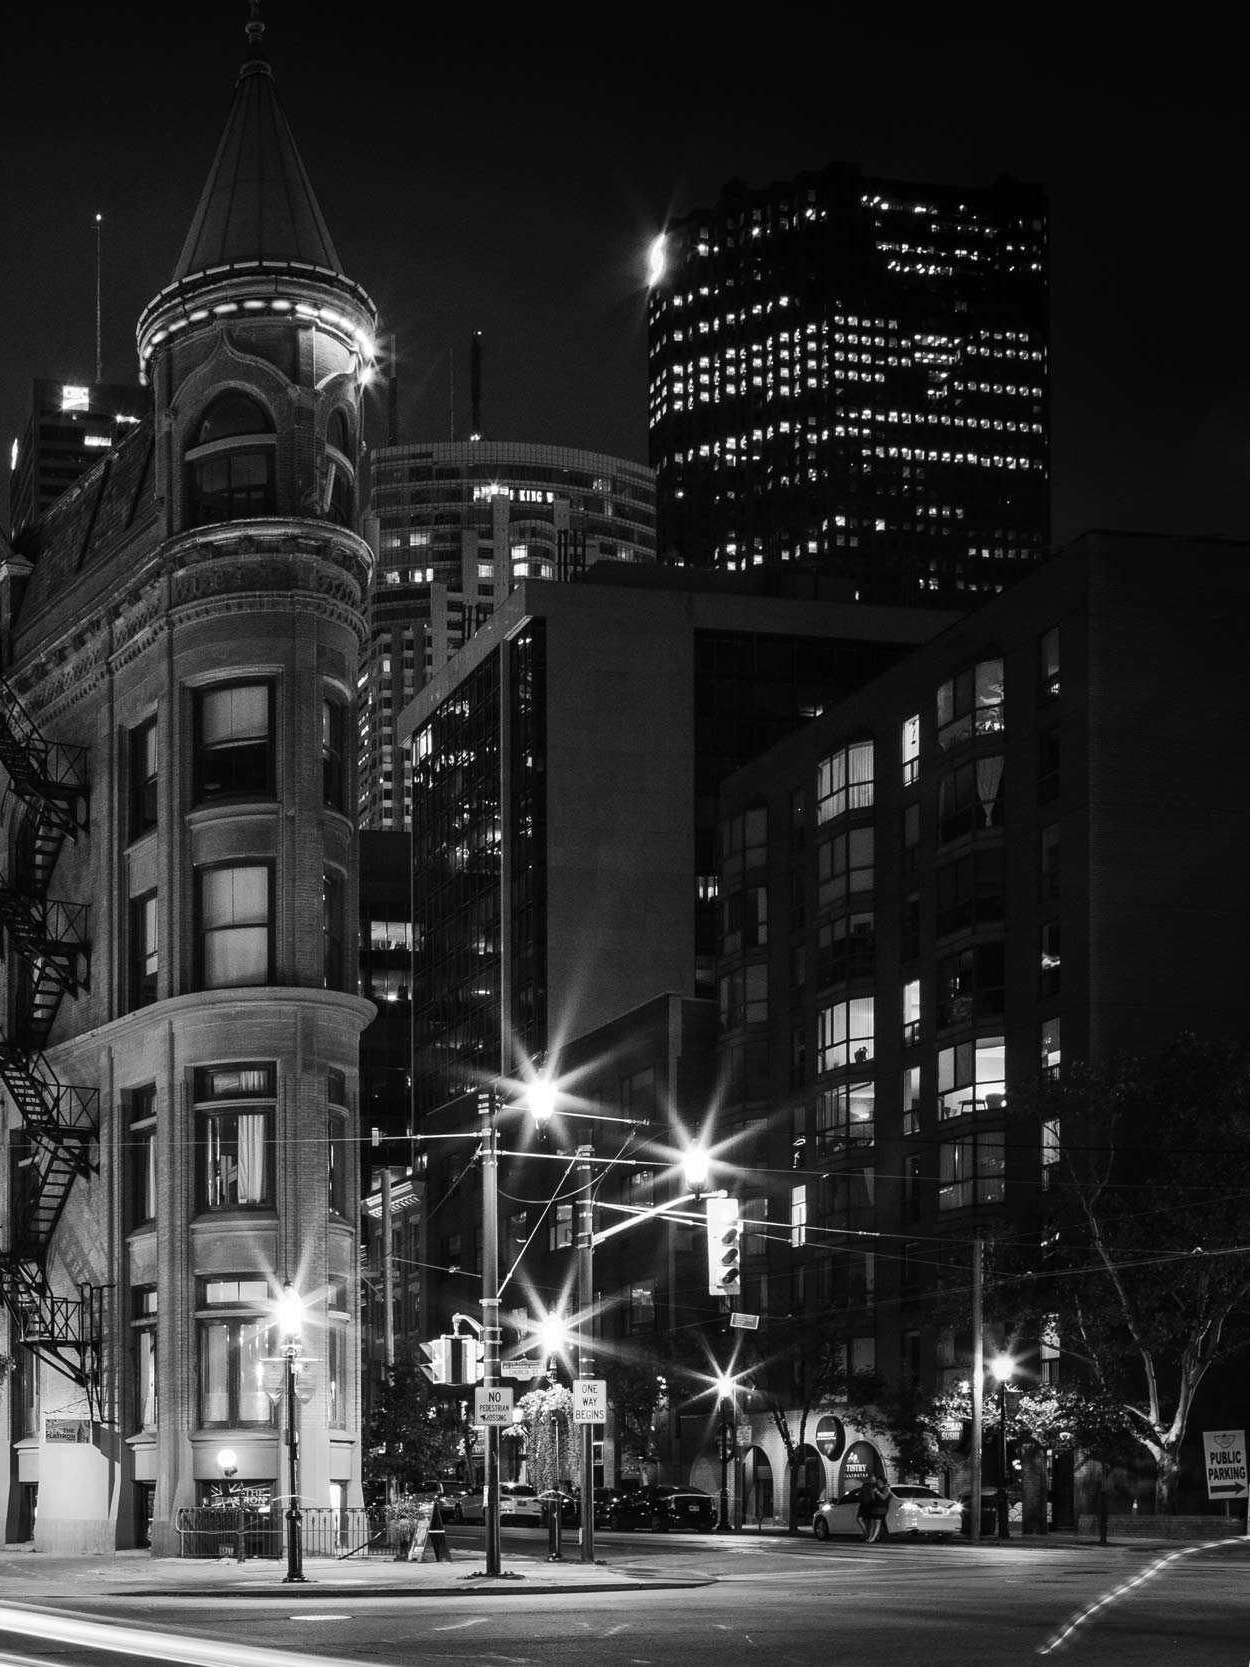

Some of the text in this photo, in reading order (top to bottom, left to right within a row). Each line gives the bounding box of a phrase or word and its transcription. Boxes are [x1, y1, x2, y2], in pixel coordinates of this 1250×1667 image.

[519, 490, 542, 503] KING
[581, 1384, 598, 1394] ONE
[488, 1392, 501, 1402] NO
[582, 1397, 598, 1407] WAY
[479, 1404, 509, 1412] PEDESTRIAN
[575, 1410, 605, 1419] BEGINS
[941, 1432, 960, 1440] SUSHI
[1210, 1451, 1242, 1465] PUBLIC
[846, 1464, 867, 1472] TISTRY
[1208, 1466, 1246, 1480] PARKING
[215, 1496, 266, 1504] FLATRON
